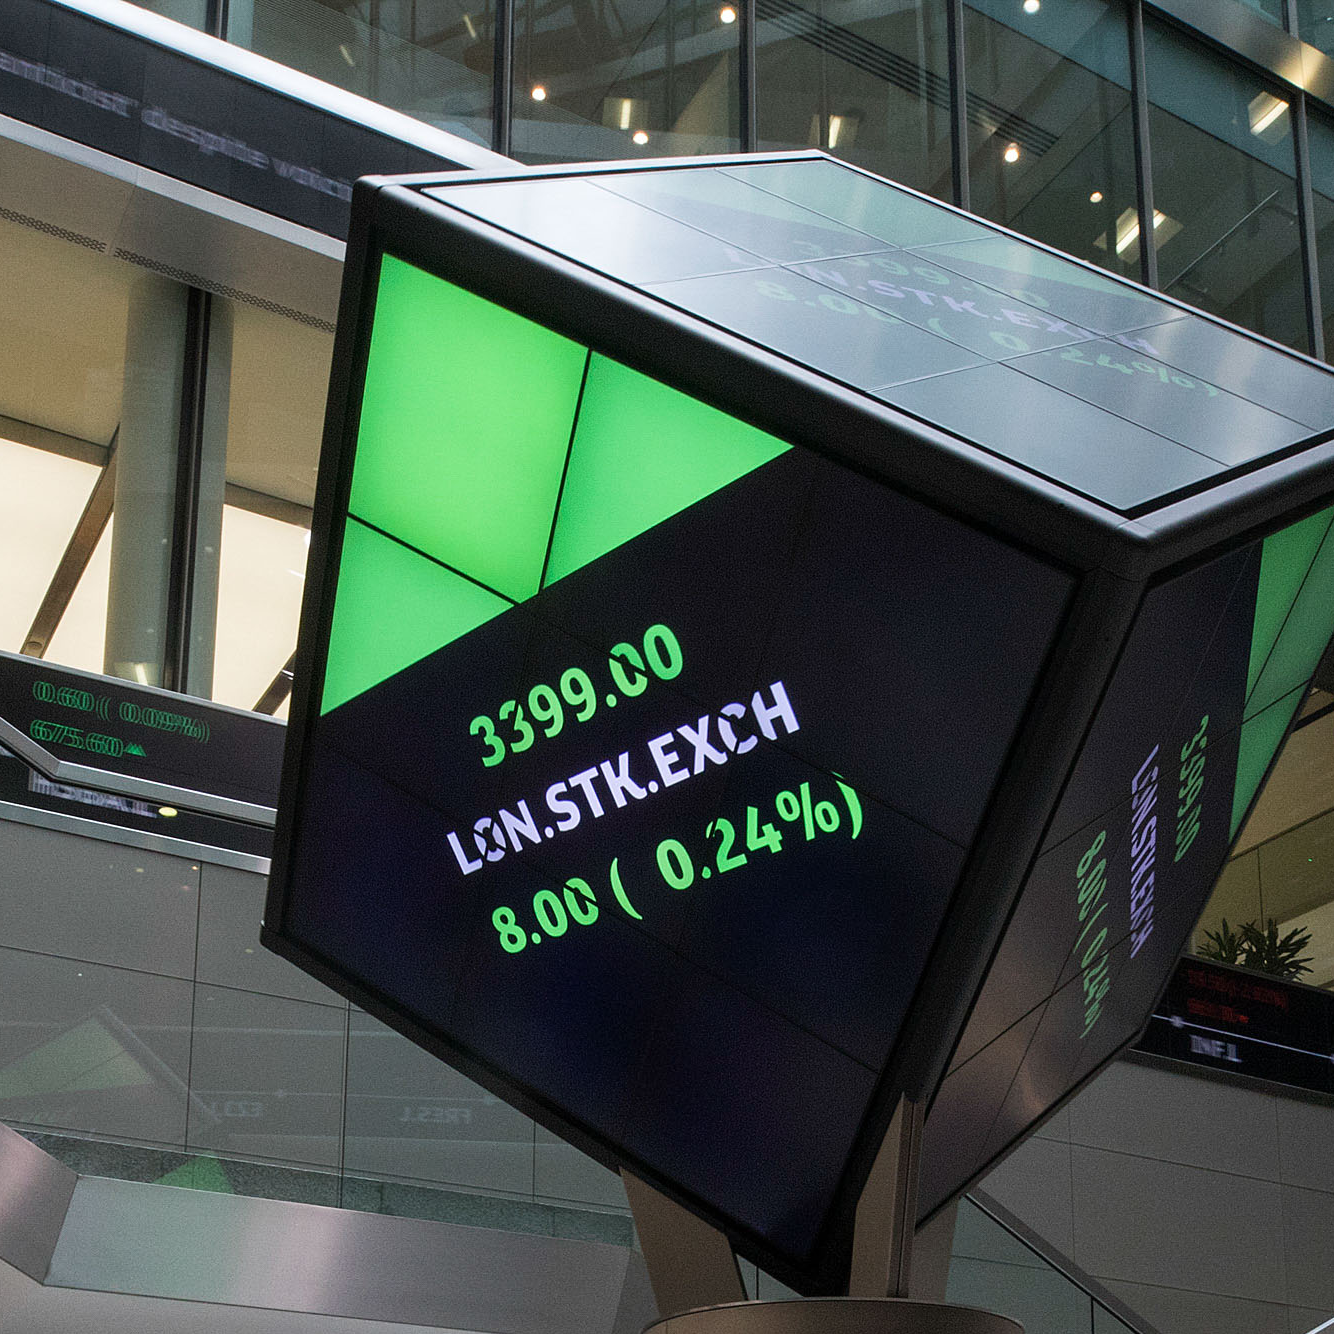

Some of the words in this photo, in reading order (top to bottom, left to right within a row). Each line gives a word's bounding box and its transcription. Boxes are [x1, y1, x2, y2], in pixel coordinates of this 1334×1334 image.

[447, 680, 800, 875] LON.STK.EXCH
[469, 623, 683, 767] 3399.00
[491, 877, 600, 954] 8.00
[655, 771, 864, 890] 0.24%)
